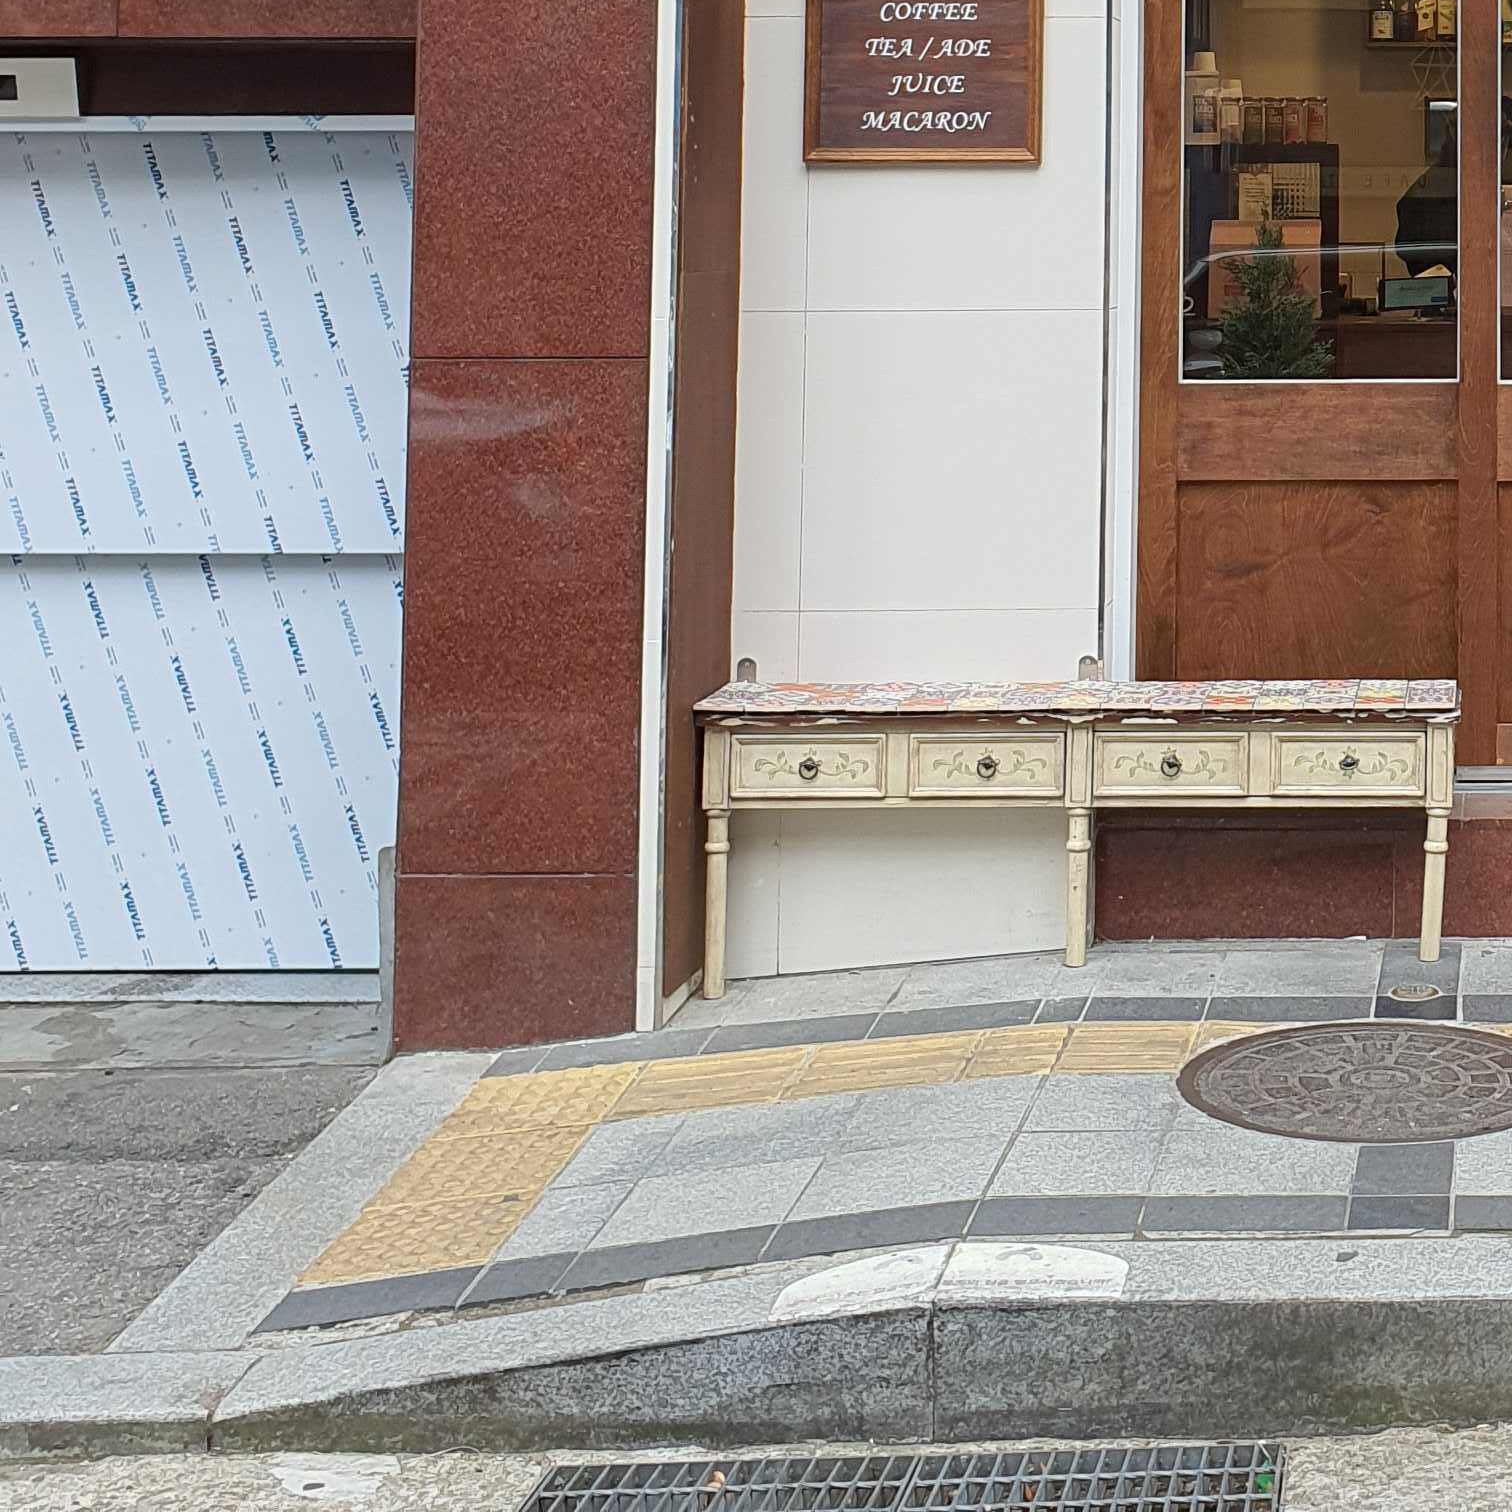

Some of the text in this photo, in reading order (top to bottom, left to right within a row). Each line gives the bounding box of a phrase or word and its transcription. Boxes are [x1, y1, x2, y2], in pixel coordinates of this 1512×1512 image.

[879, 2, 978, 21] COFFEE
[865, 38, 913, 57] TEA
[933, 38, 991, 58] ADE
[888, 74, 966, 96] JUICE
[861, 111, 992, 133] MACARON
